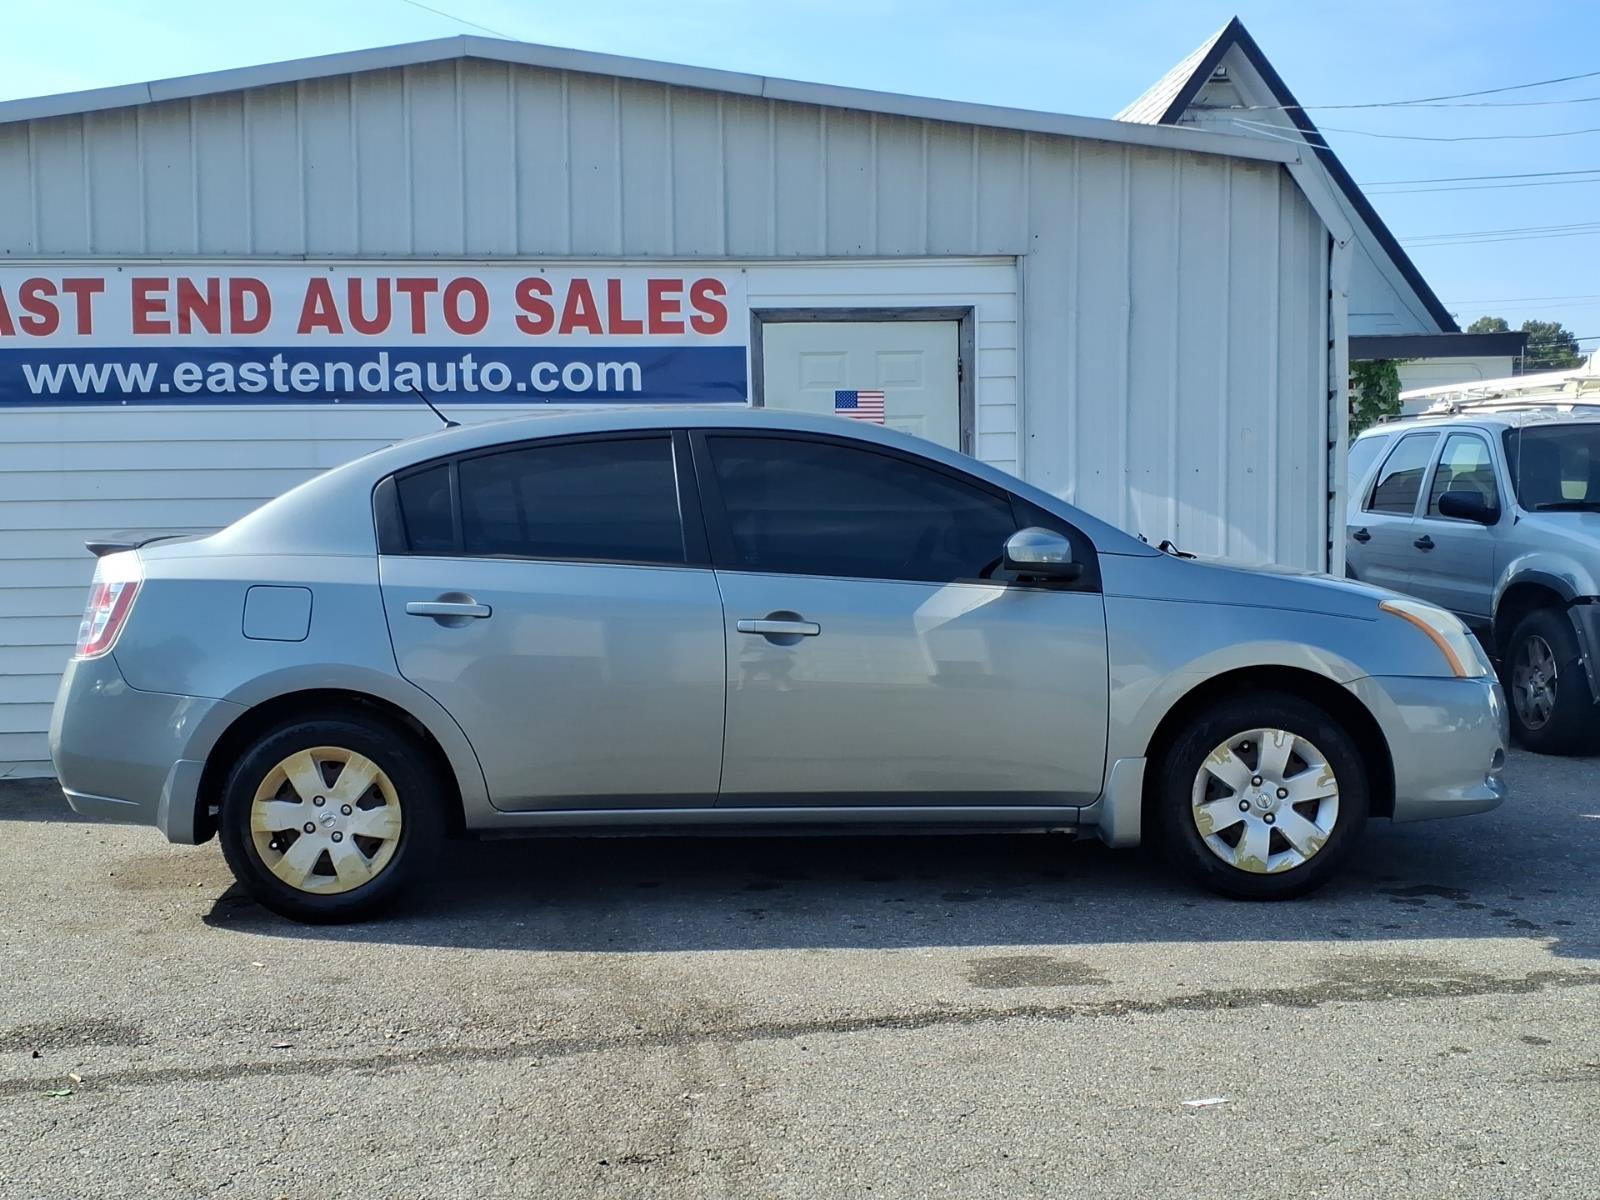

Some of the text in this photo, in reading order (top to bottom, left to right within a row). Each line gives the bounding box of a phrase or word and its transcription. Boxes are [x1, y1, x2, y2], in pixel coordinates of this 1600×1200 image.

[132, 278, 271, 335] END
[297, 276, 490, 336] AUTO
[515, 277, 728, 336] SALES
[21, 351, 643, 394] www.eastendauto.com
